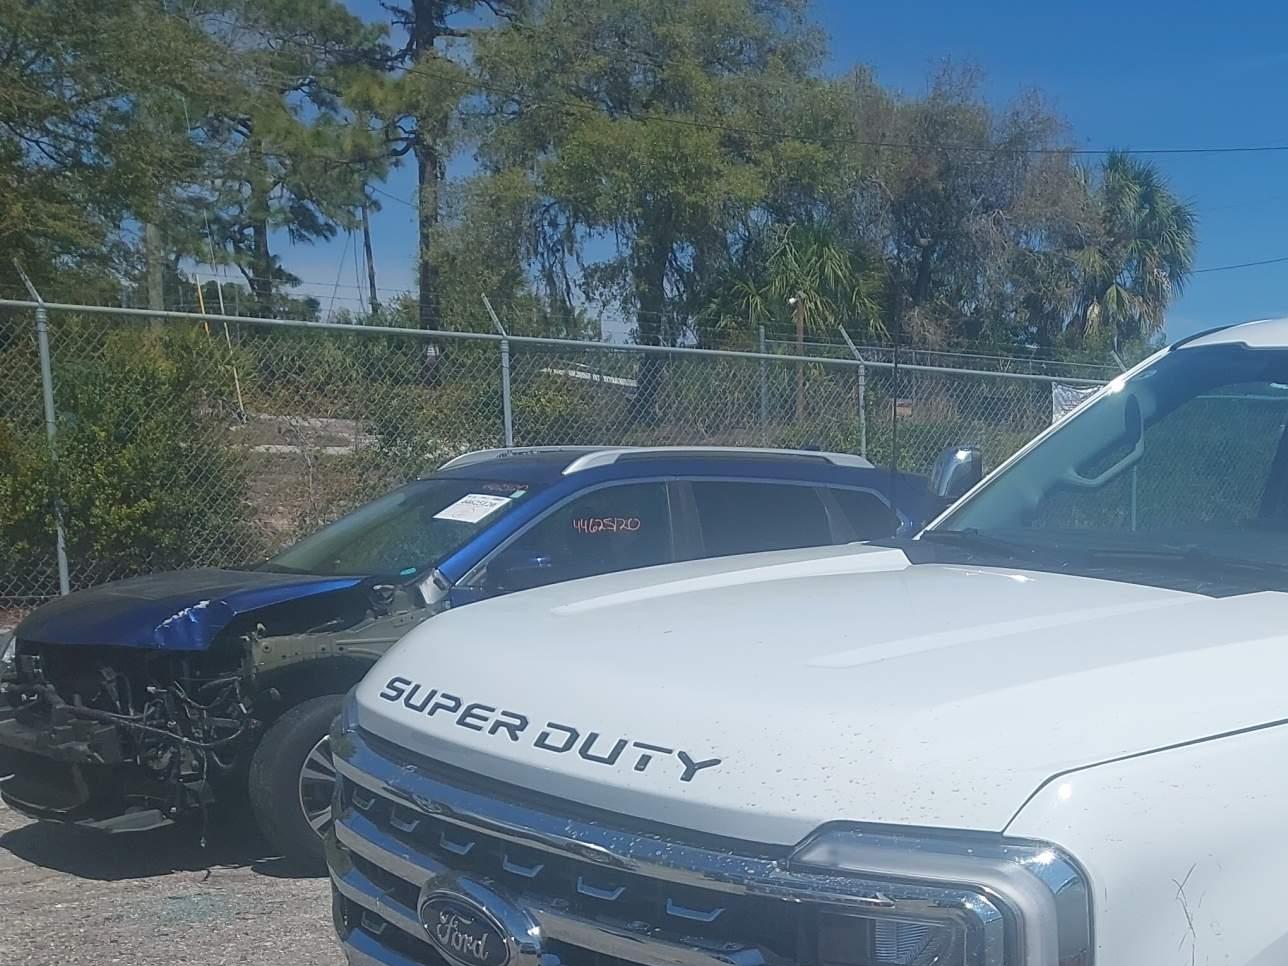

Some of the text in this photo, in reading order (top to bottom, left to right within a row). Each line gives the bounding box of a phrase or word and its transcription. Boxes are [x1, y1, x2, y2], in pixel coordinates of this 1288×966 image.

[573, 517, 641, 534] 44625120
[379, 675, 722, 784] SUPER DUTY
[436, 911, 489, 961] Ford
